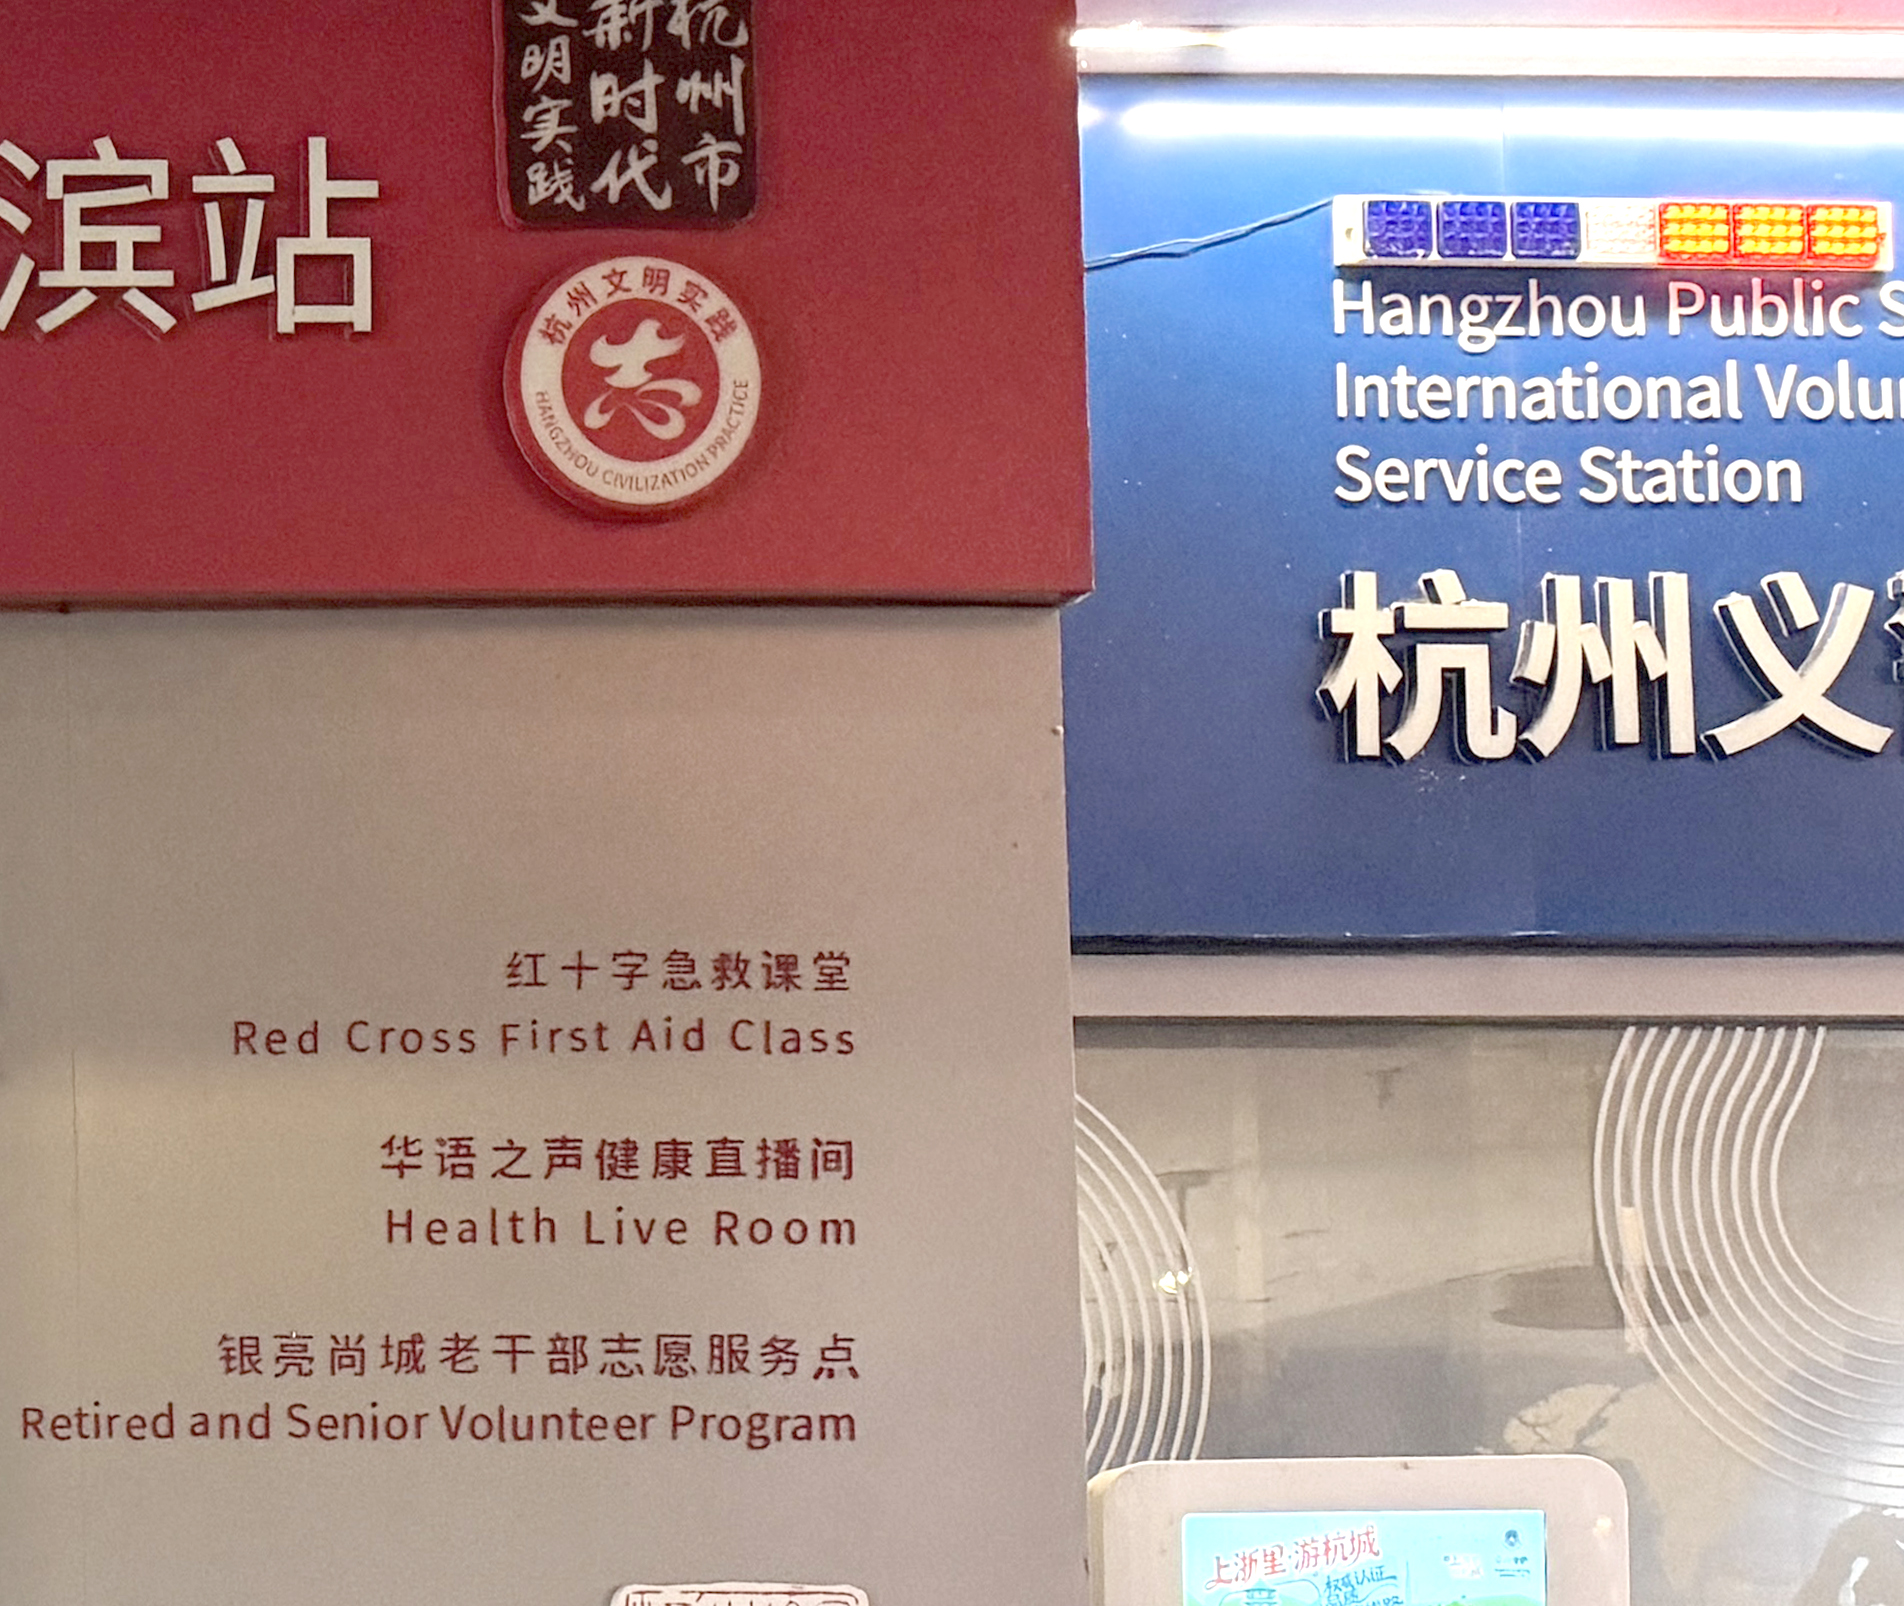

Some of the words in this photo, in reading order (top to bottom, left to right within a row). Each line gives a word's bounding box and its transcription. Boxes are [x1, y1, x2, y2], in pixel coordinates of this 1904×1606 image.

[538, 264, 738, 348] 杭州文明实践
[1332, 278, 1648, 354] Hangzhou
[1668, 278, 1863, 338] Public
[1335, 360, 1743, 421] International
[1755, 359, 1904, 421] Volu
[535, 389, 601, 481] HANGZHOU
[602, 455, 713, 493] CIVILIZATION
[709, 378, 750, 463] PRACTICE
[1334, 443, 1563, 504] Service
[1578, 443, 1803, 504] Station
[1316, 568, 1904, 764] 杭州义
[506, 950, 852, 993] 红十字急救课堂
[233, 1020, 321, 1056] Red
[346, 1020, 478, 1056] Cross
[500, 1020, 609, 1055] First
[632, 1017, 706, 1055] Aid
[730, 1019, 856, 1056] Class
[380, 1135, 855, 1182] 华语之声健康直播间
[386, 1208, 557, 1246] Health
[585, 1208, 689, 1246] Live
[714, 1209, 857, 1246] Room
[218, 1331, 861, 1380] 银亮尚城老干部志愿服务点
[21, 1403, 175, 1442] Retired
[189, 1405, 273, 1441] and
[287, 1404, 430, 1442] Senior
[439, 1405, 658, 1442] Volunteer
[669, 1405, 857, 1449] Program
